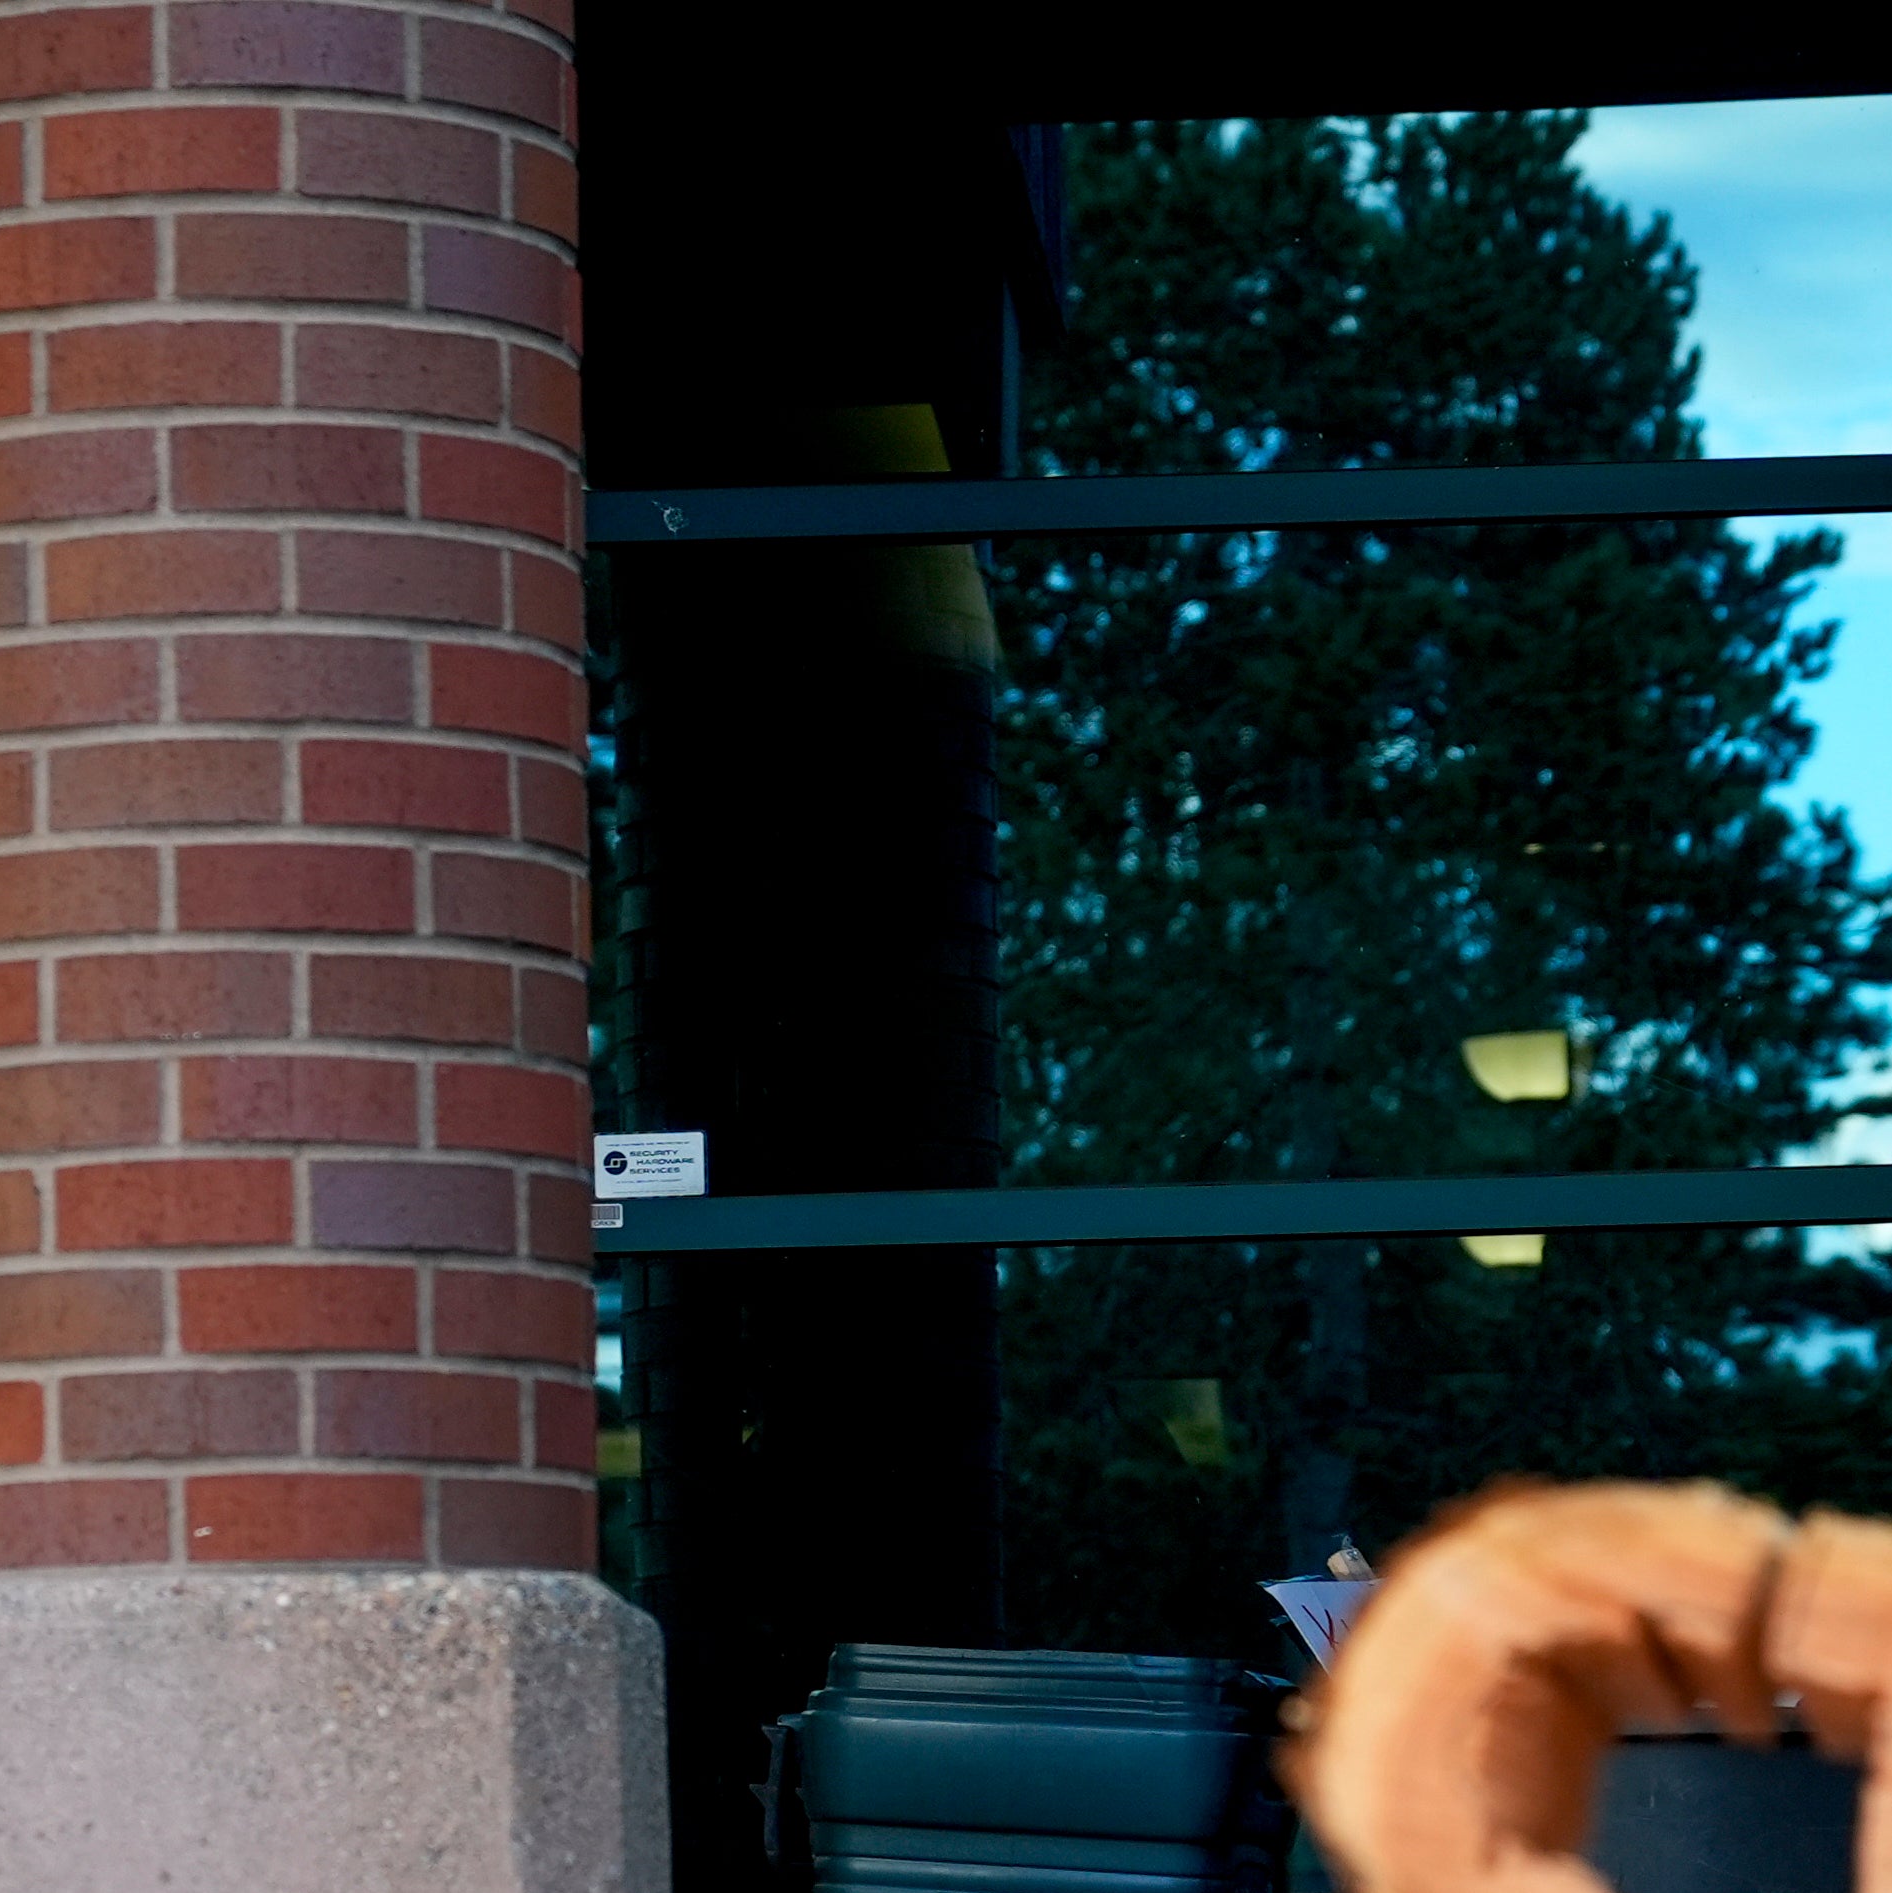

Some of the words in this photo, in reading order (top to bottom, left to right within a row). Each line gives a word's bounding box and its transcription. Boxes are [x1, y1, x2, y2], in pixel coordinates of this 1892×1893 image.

[629, 1149, 679, 1157] SECURITY
[636, 1157, 696, 1166] HARDWARE
[629, 1167, 681, 1175] SERVICES
